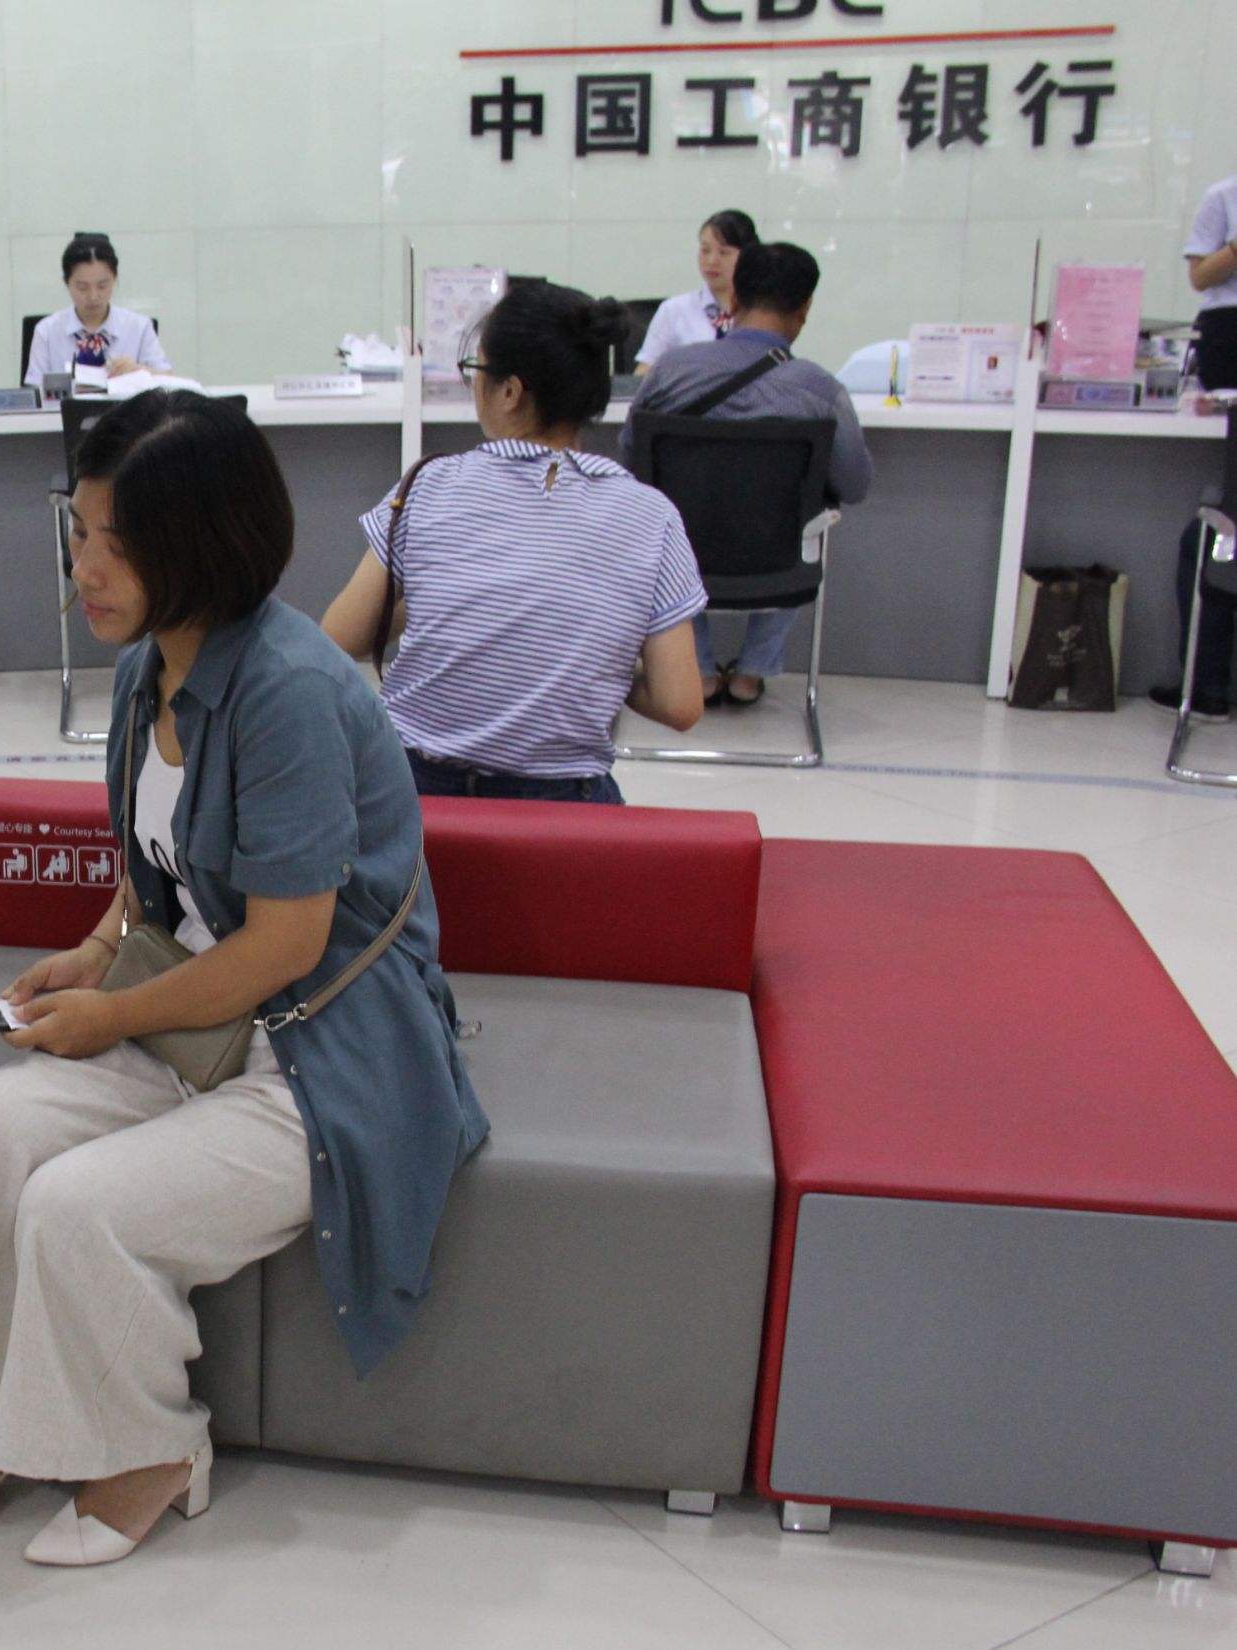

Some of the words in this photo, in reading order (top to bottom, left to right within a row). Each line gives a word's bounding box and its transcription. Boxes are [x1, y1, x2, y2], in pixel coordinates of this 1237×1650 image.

[470, 59, 1115, 161] 中国工商银行
[53, 826, 93, 838] Courtesy
